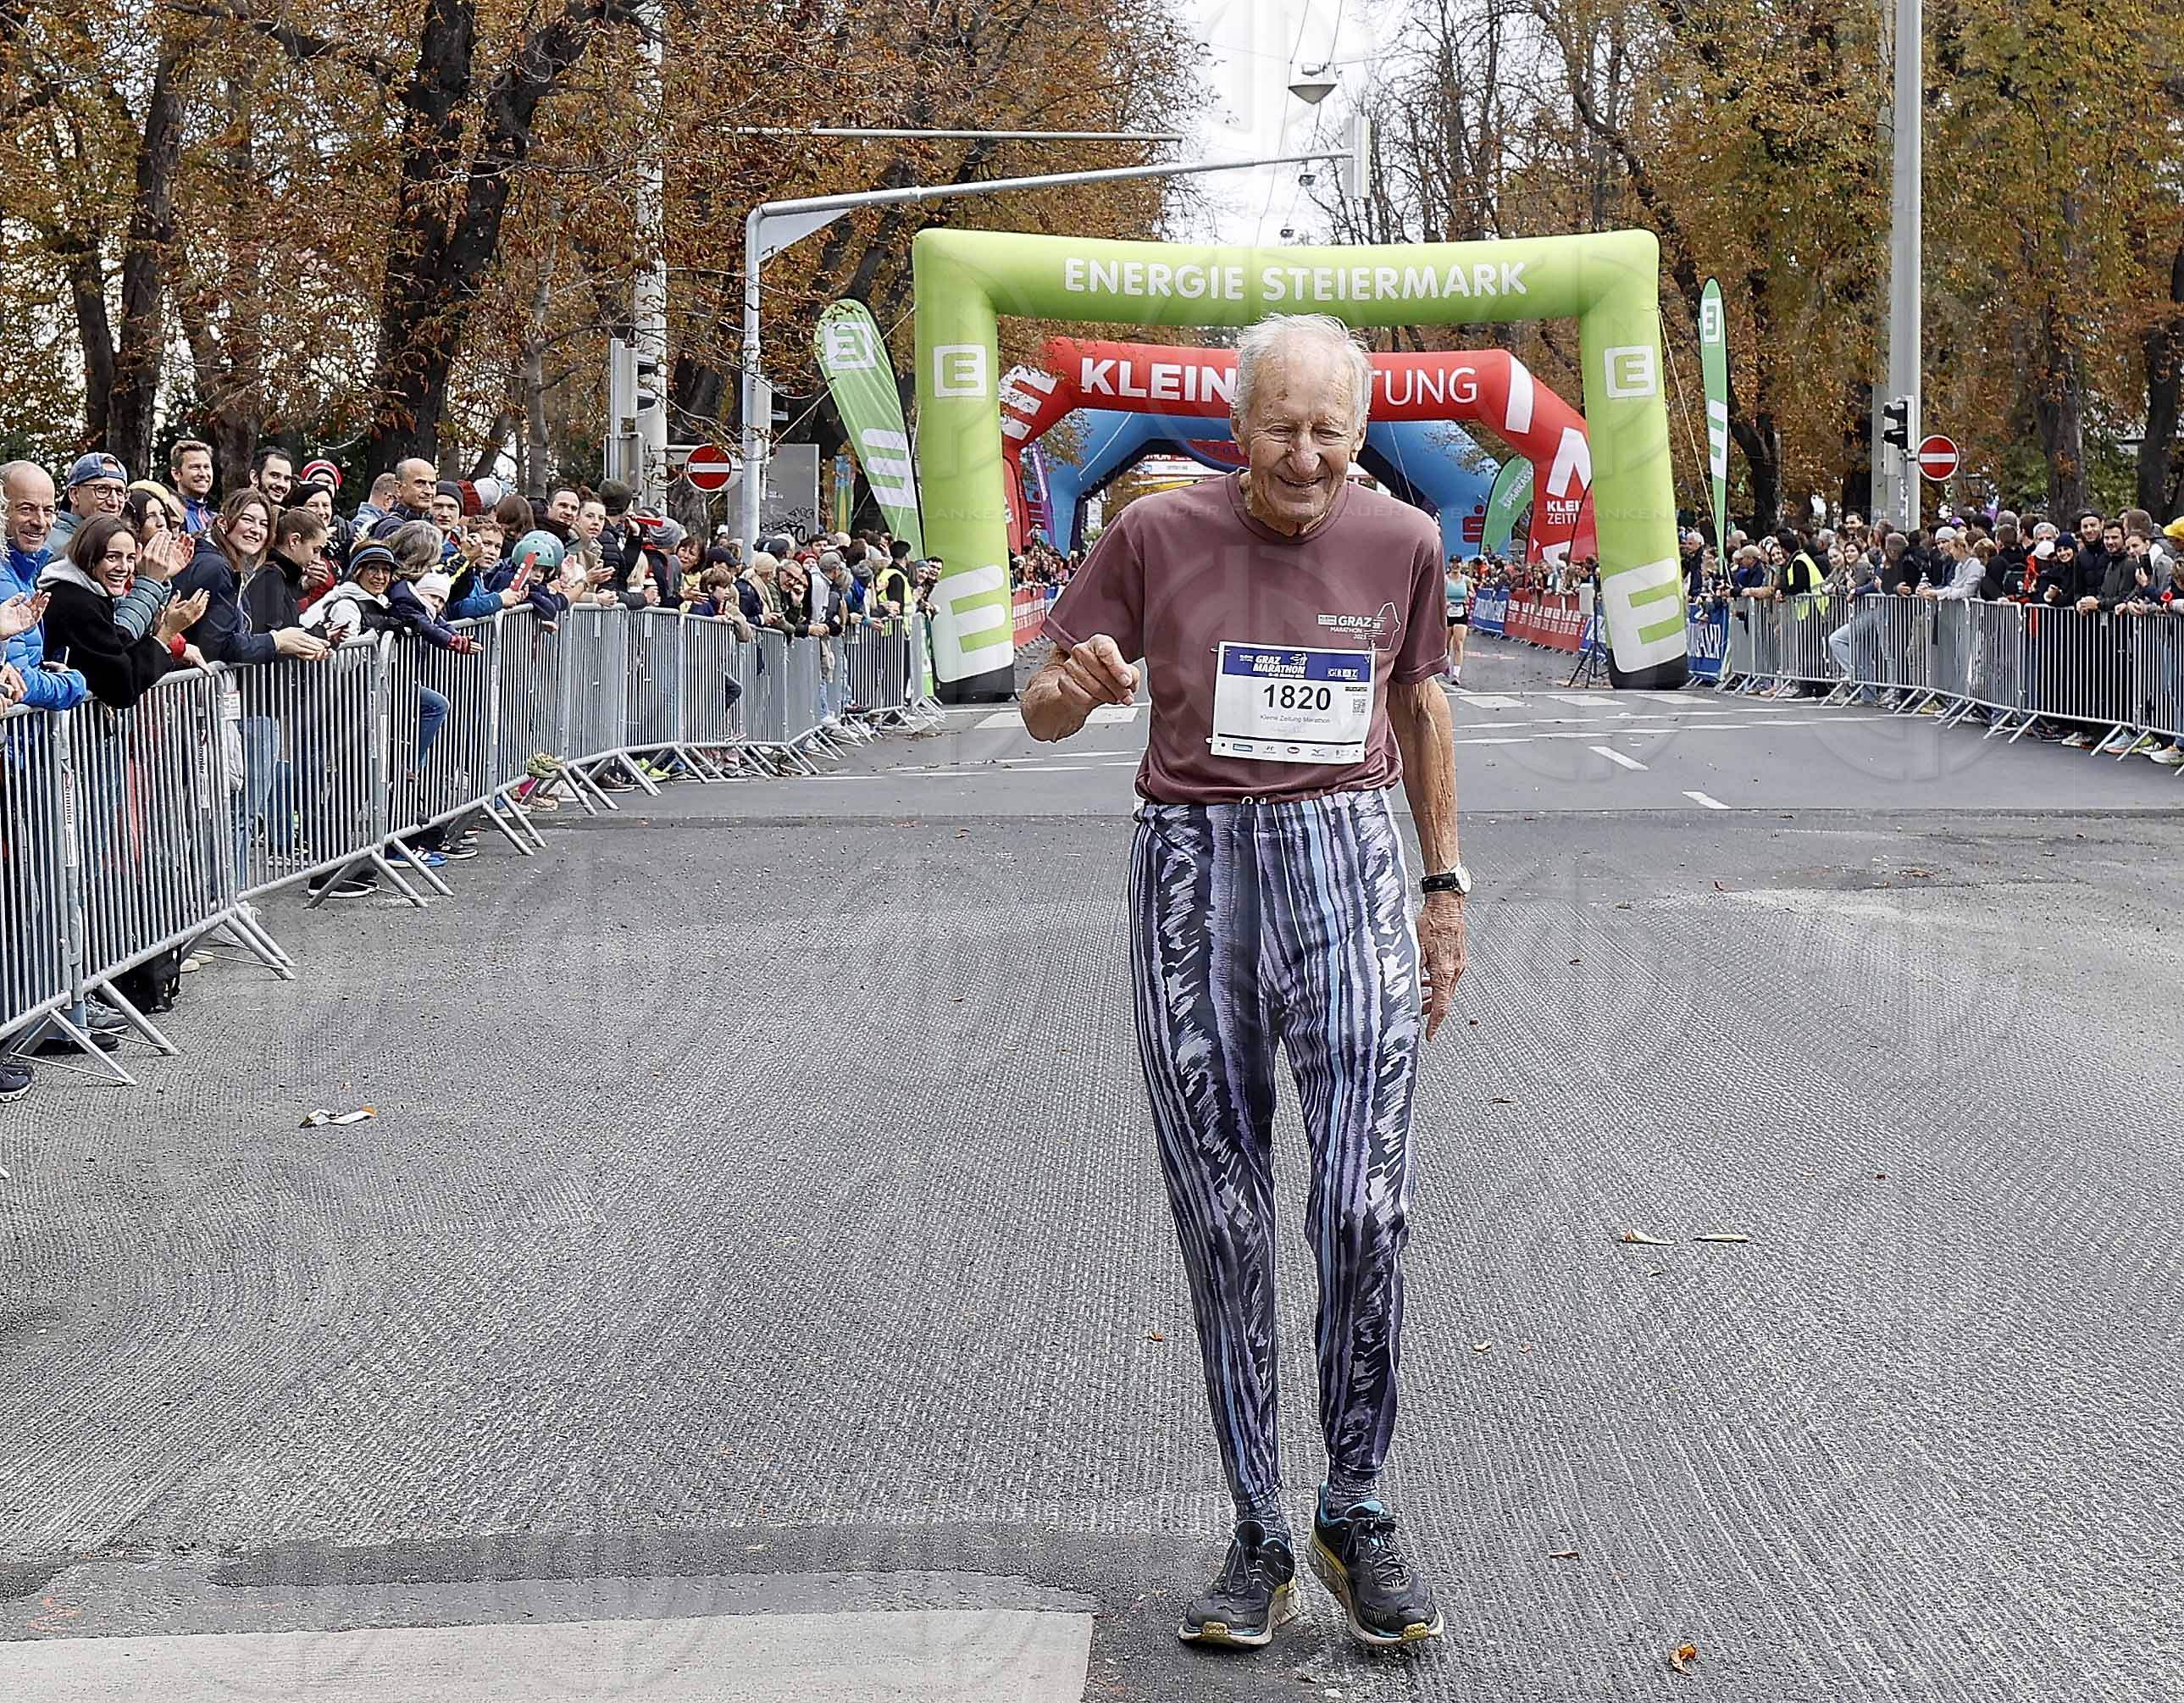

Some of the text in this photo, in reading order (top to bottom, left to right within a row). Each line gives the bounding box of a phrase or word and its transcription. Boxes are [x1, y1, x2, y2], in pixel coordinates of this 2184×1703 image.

[1064, 257, 1527, 301] ENERGIE STEIERMARK
[1081, 357, 1237, 404] KLEIN
[1546, 500, 1581, 512] KLEI
[1339, 616, 1372, 627] GRAZ
[1256, 655, 1281, 665] GRAZ
[1252, 663, 1306, 674] MARATHON
[1263, 684, 1331, 711] 1820
[1279, 715, 1301, 724] Zeitung
